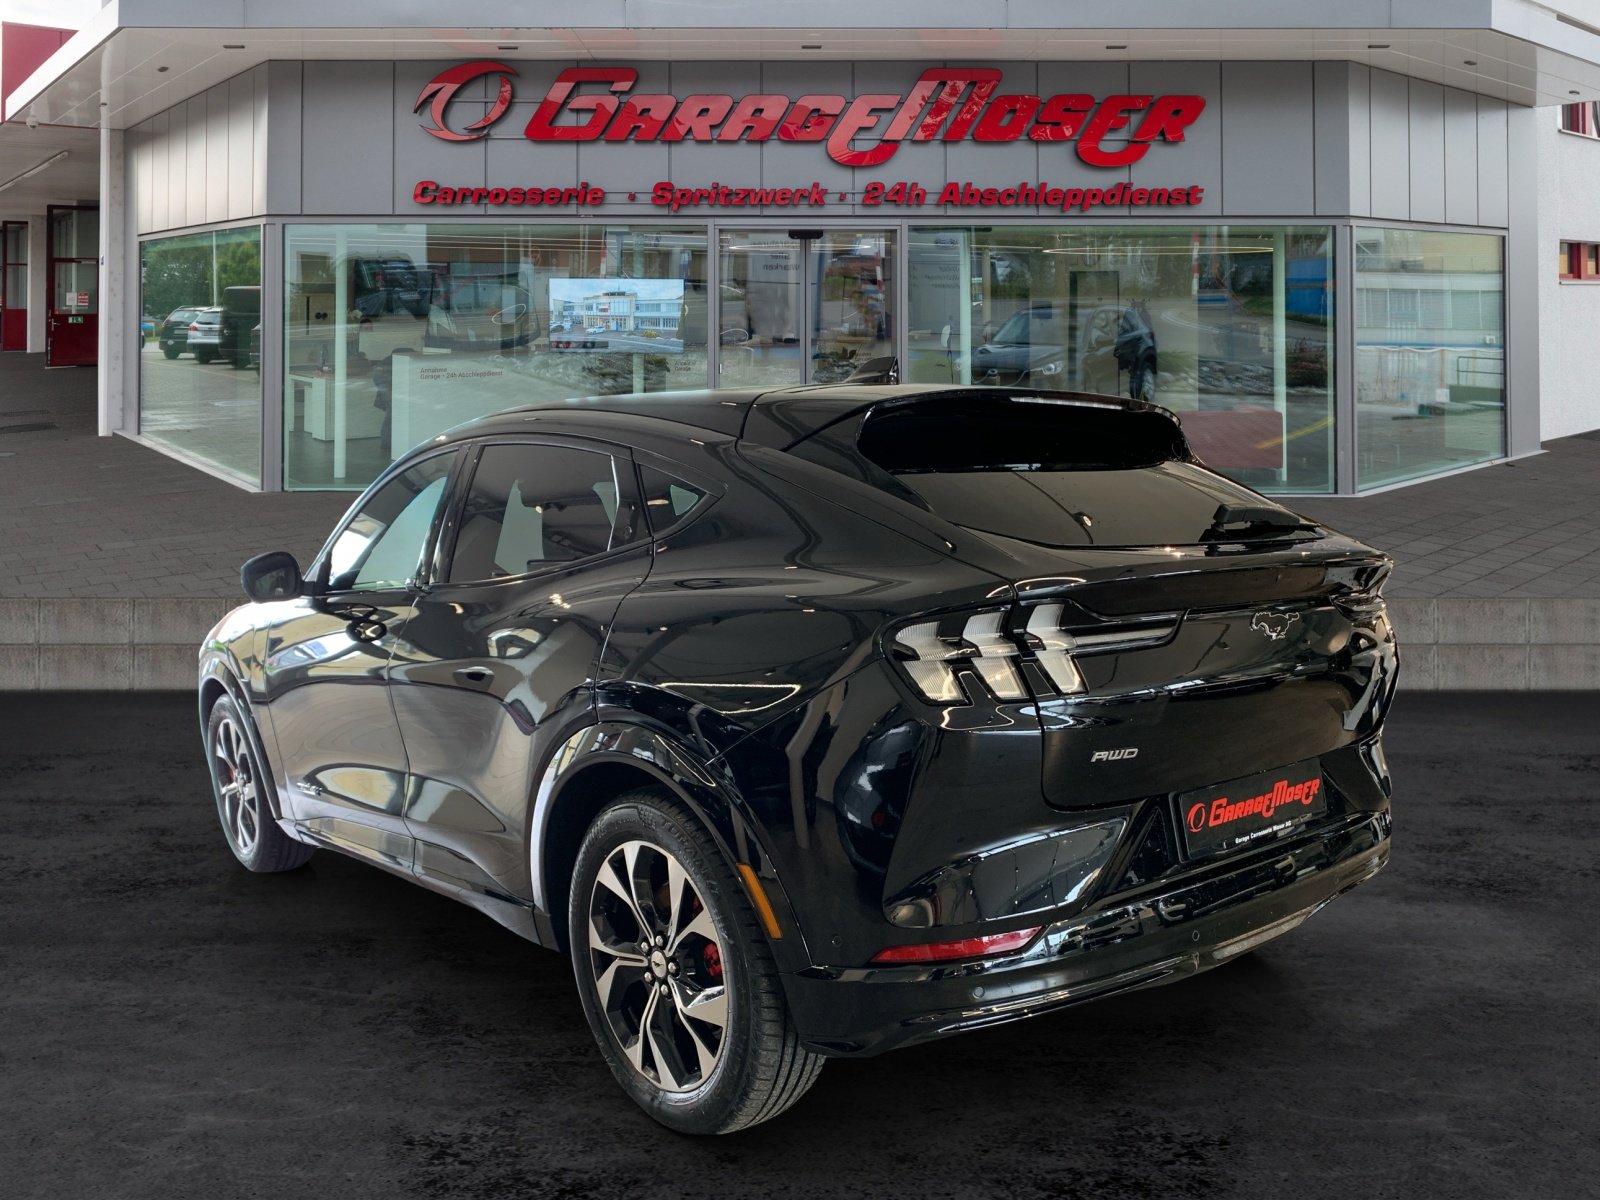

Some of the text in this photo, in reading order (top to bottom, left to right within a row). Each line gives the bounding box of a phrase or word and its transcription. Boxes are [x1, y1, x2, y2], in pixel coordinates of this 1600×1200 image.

[413, 181, 604, 206] Carrosserie
[650, 181, 827, 211] Spritzwerk
[862, 181, 927, 206] 24h
[936, 181, 1204, 212] Abschleppdienst
[1091, 748, 1139, 763] AWD
